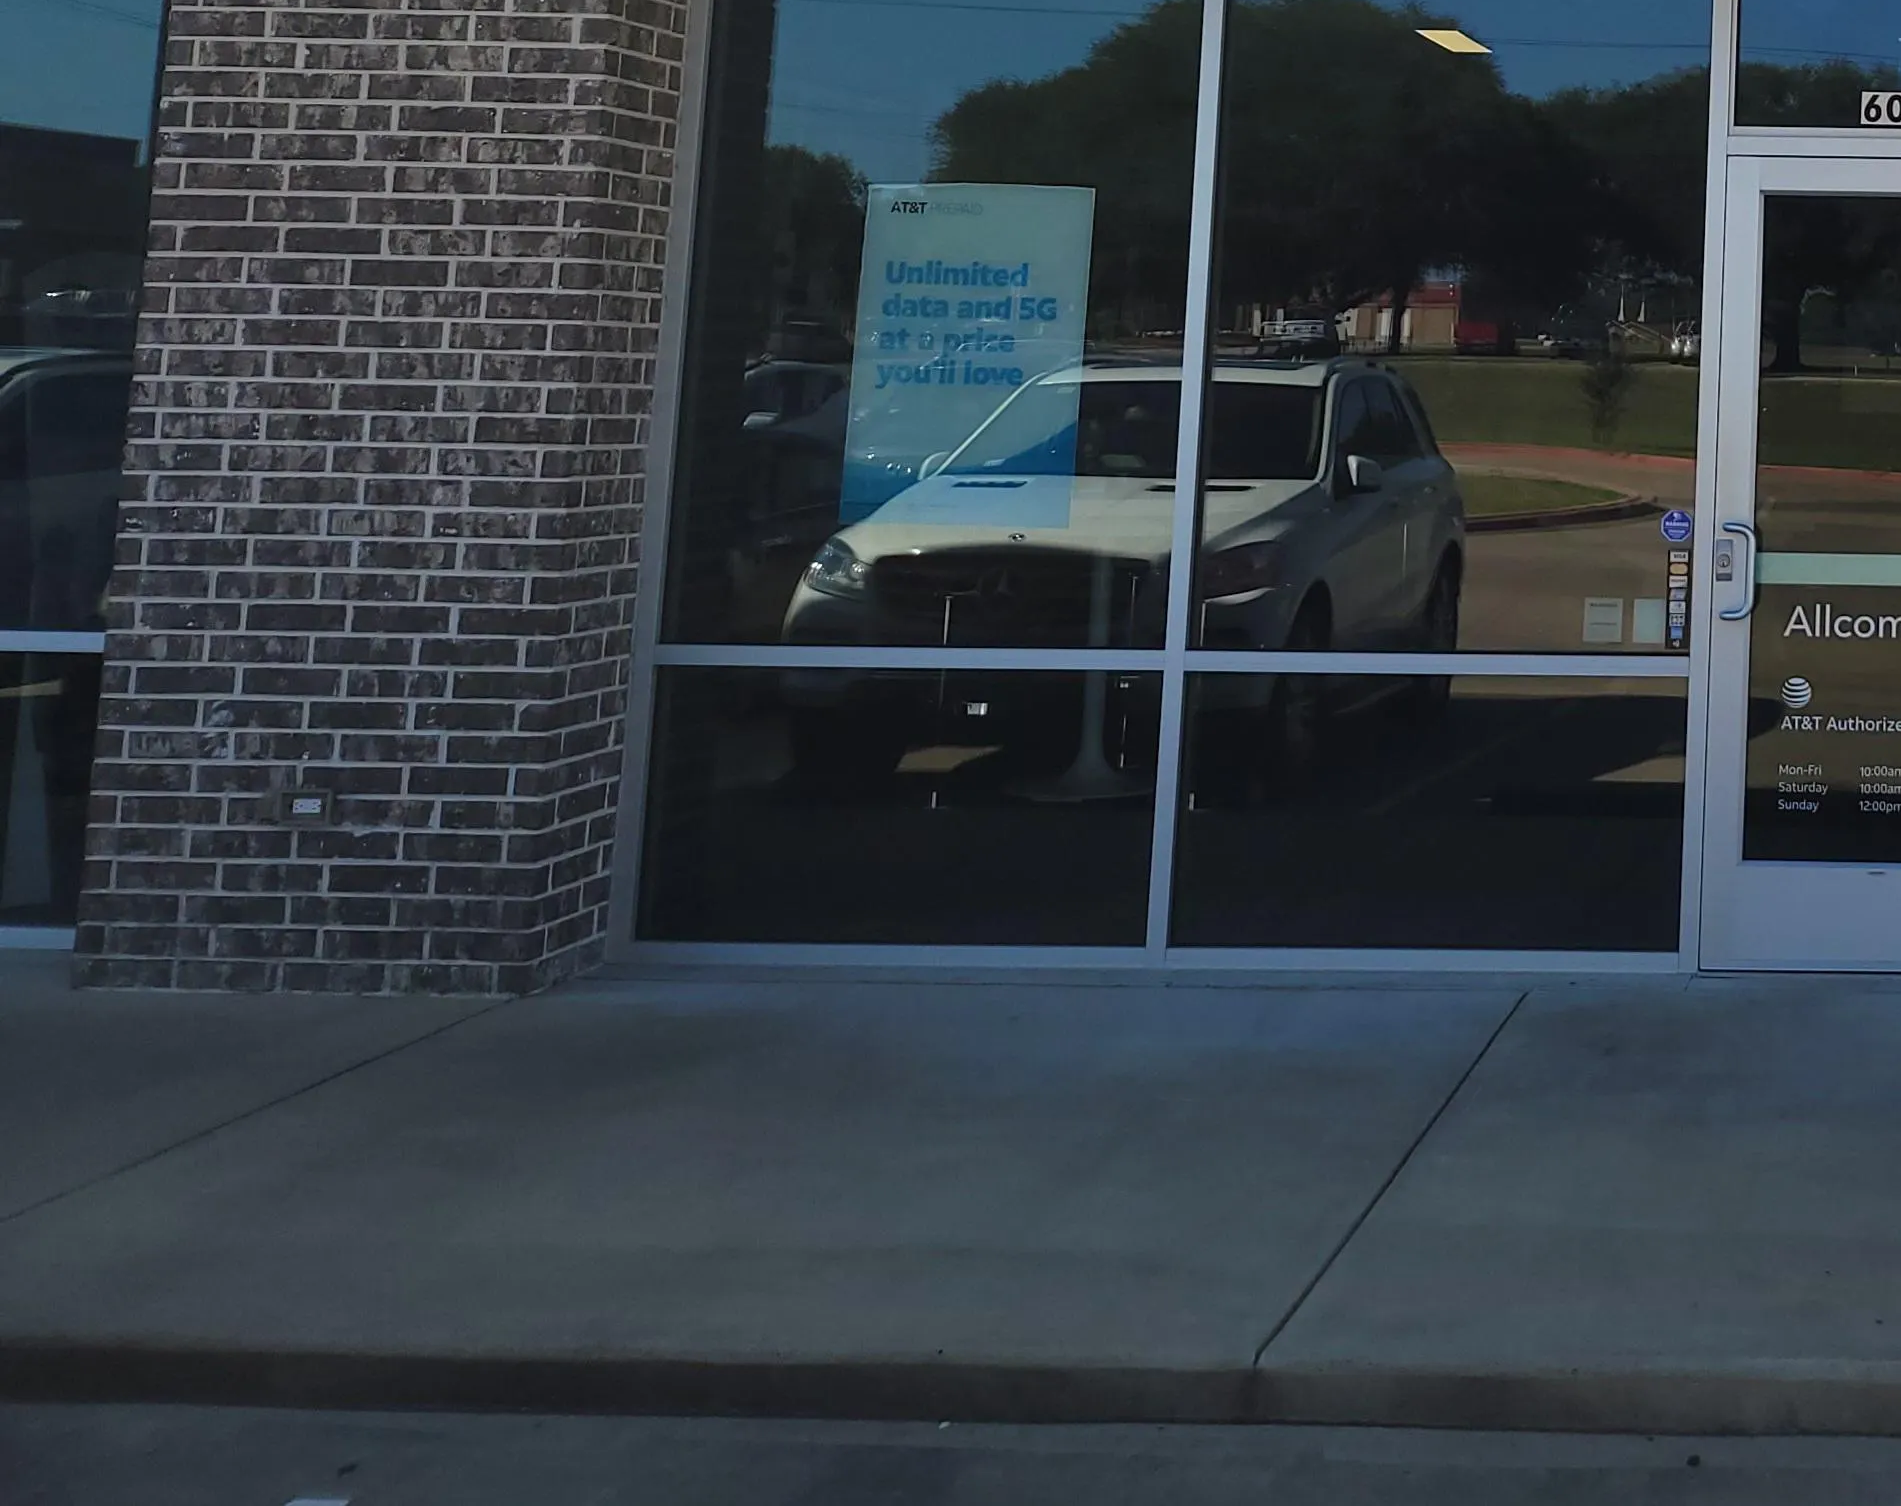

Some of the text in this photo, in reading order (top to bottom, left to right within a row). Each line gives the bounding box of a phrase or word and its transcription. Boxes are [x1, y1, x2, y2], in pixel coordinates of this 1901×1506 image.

[891, 201, 929, 214] AT&T
[885, 260, 1029, 287] Unlimited
[881, 293, 1058, 321] data and 5G
[879, 328, 910, 351] at
[942, 327, 1016, 358] price
[875, 354, 1024, 389] you'll love
[1781, 716, 1823, 731] AT&T
[1778, 764, 1823, 776] Mon-Fri
[1778, 781, 1828, 795] Saturday
[1778, 799, 1820, 813] Sunday
